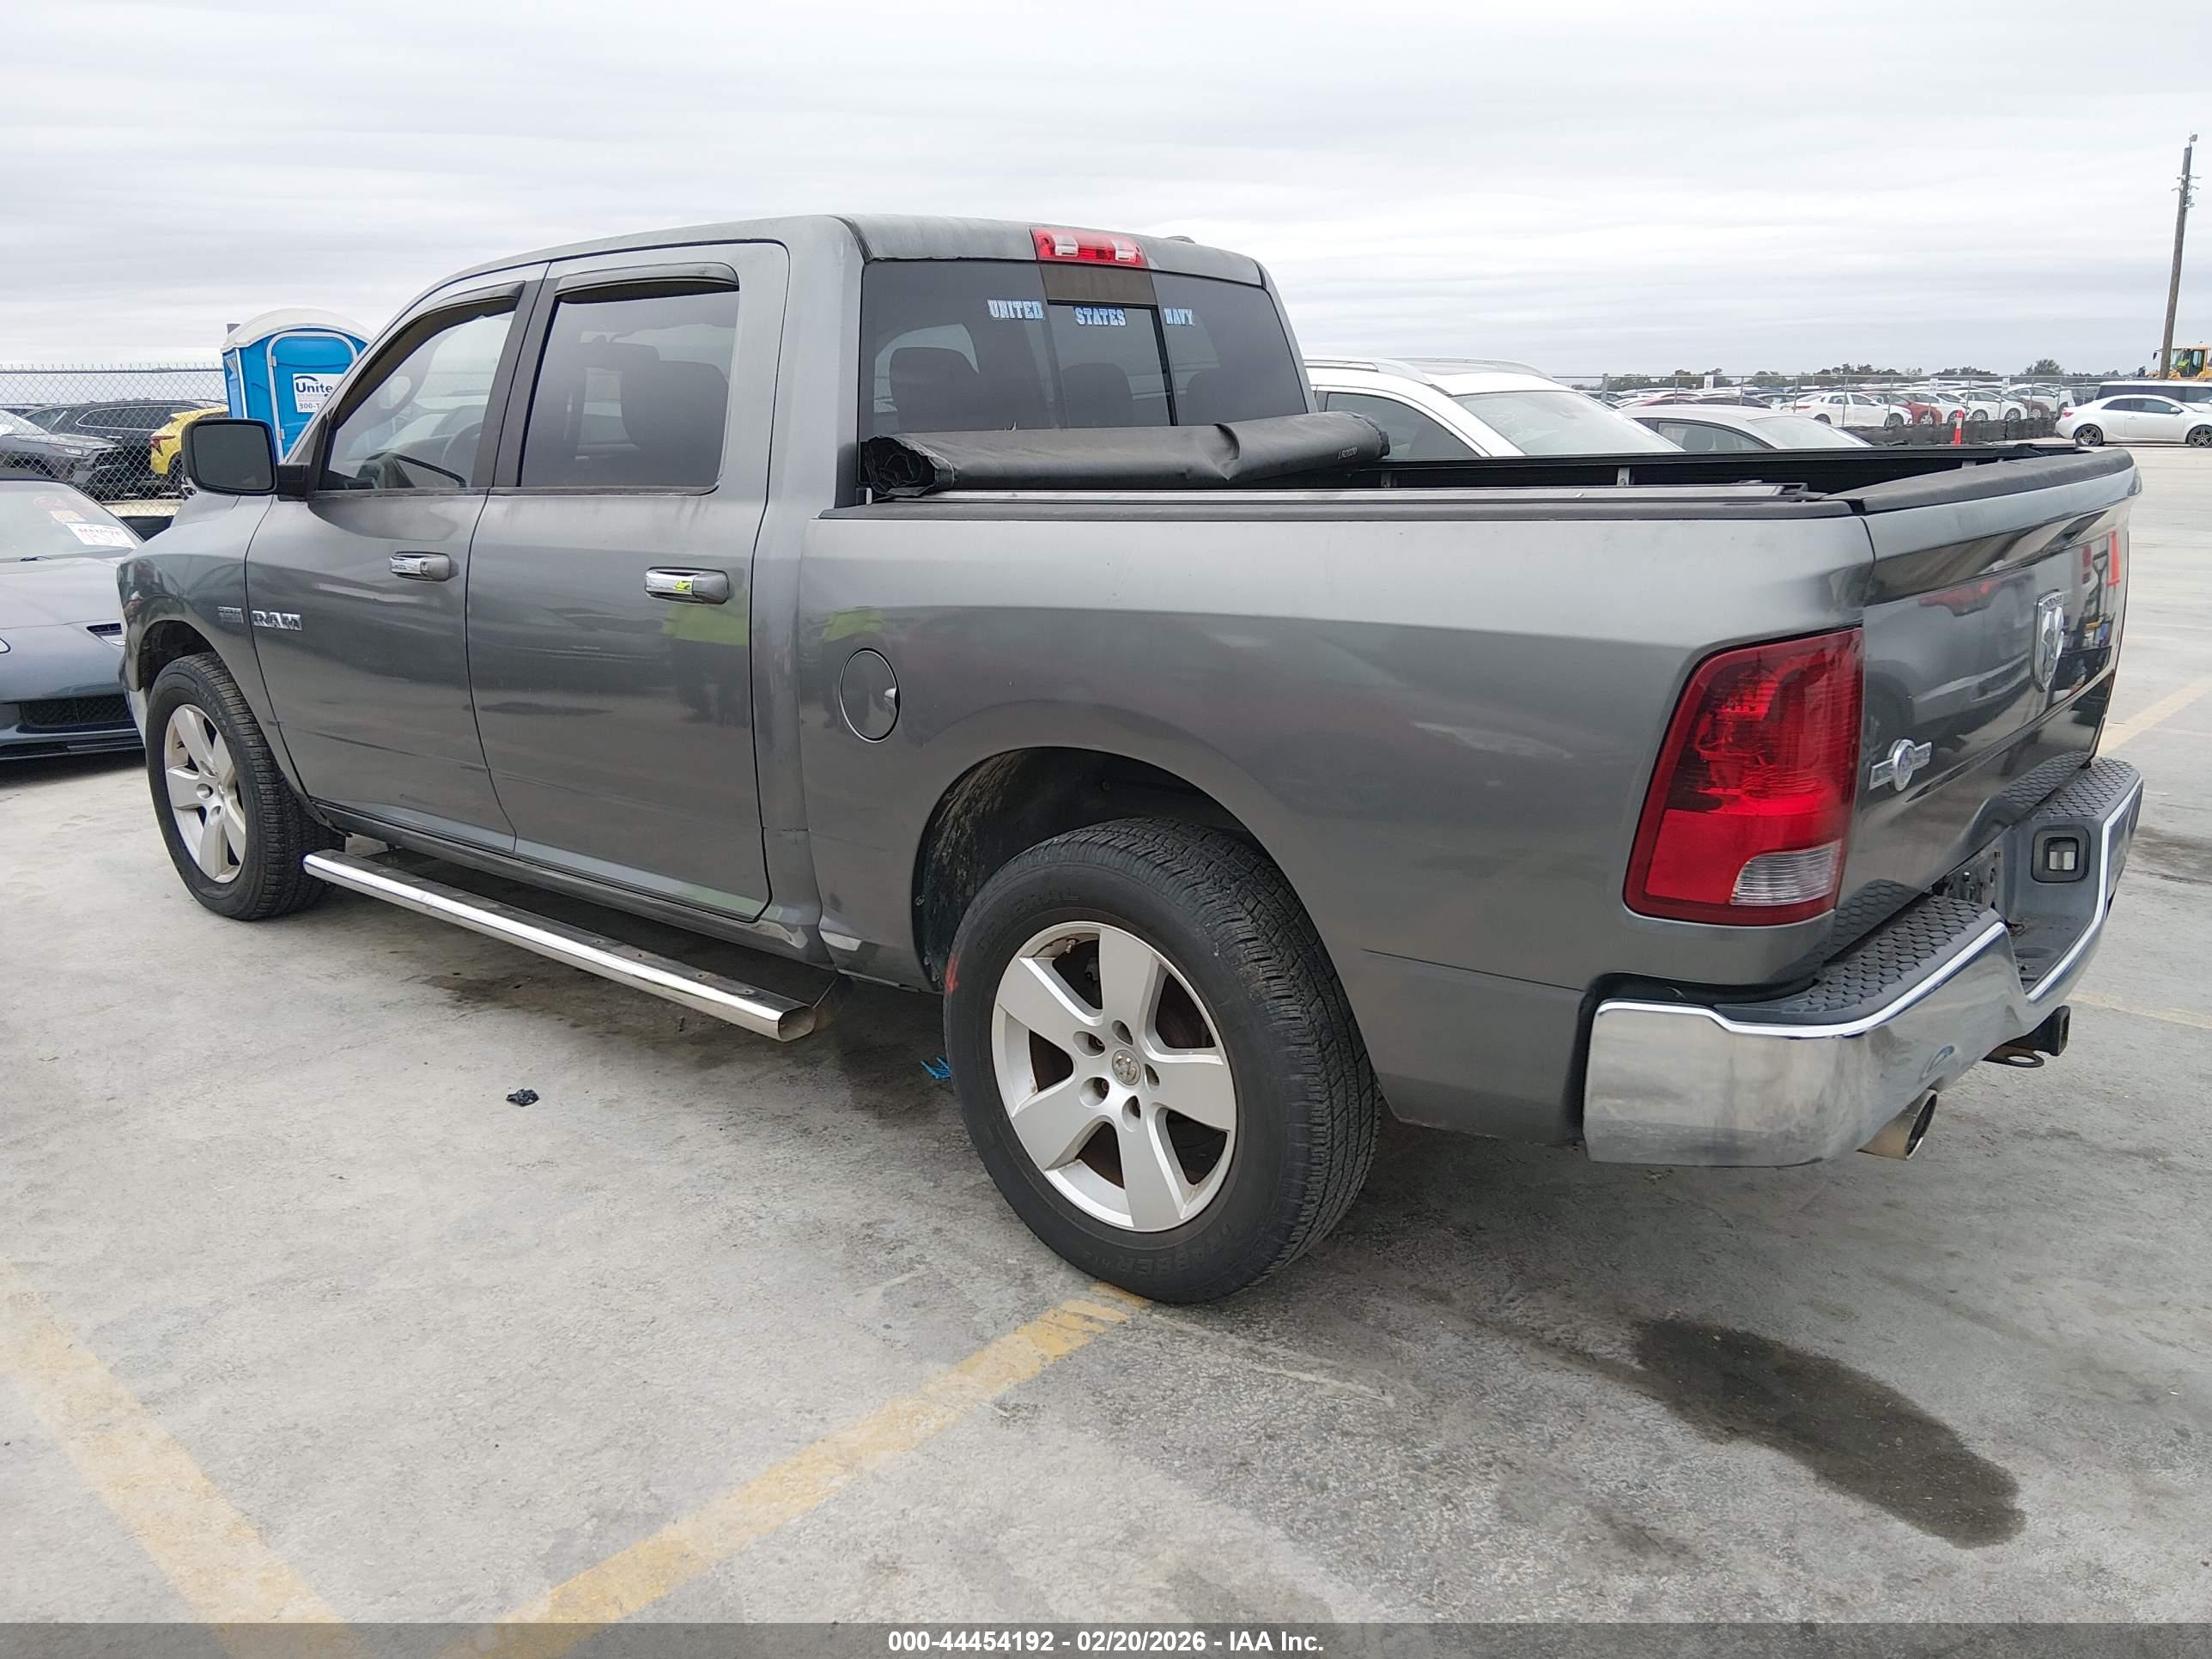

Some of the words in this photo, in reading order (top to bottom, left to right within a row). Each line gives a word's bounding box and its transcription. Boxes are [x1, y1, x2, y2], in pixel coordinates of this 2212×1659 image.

[987, 299, 1044, 319] UNITED
[1074, 307, 1127, 326] STATES
[1164, 308, 1194, 325] NAVY
[295, 381, 333, 393] Unite
[252, 610, 302, 631] RAM
